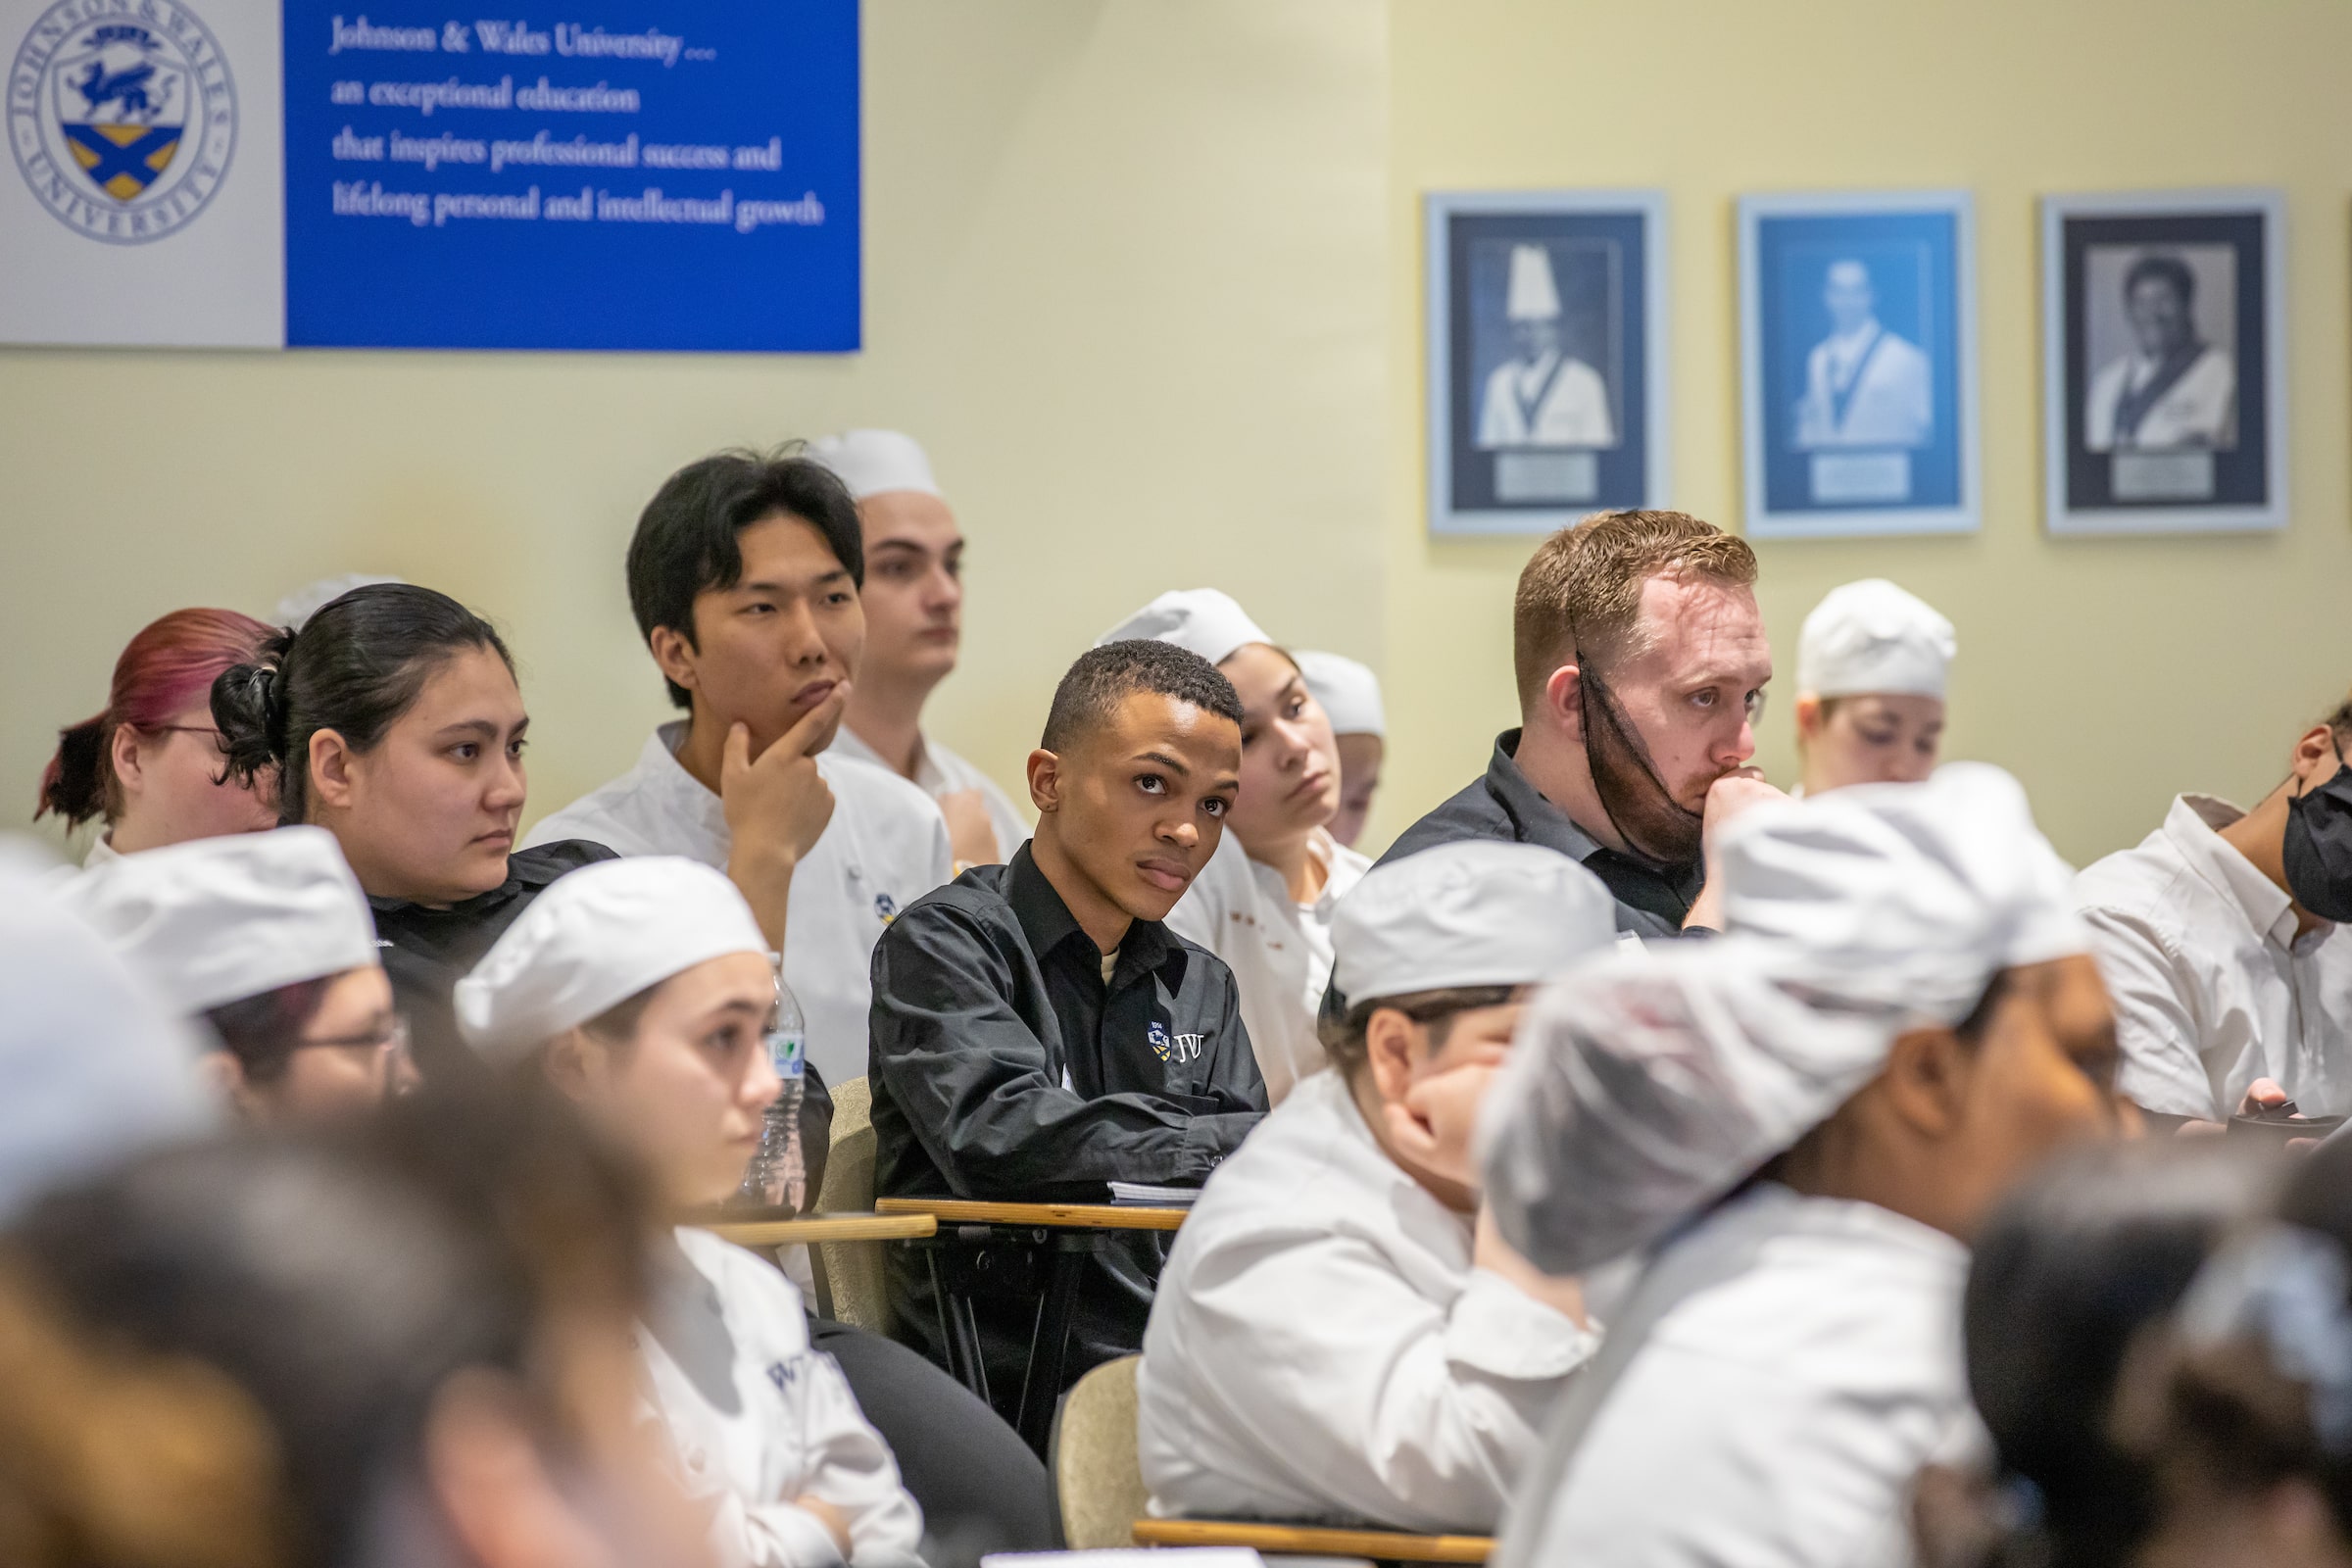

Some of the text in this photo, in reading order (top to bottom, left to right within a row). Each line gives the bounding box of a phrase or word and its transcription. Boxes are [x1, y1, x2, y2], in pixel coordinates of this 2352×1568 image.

[328, 15, 437, 55] Johnson
[441, 20, 470, 53] &
[475, 19, 552, 55] Wales
[331, 74, 641, 117] an exceptional education
[332, 124, 783, 173] that inspires professional success and
[26, 151, 220, 233] UNIVERSITY
[332, 180, 826, 234] lifelong personal and intellectual growth
